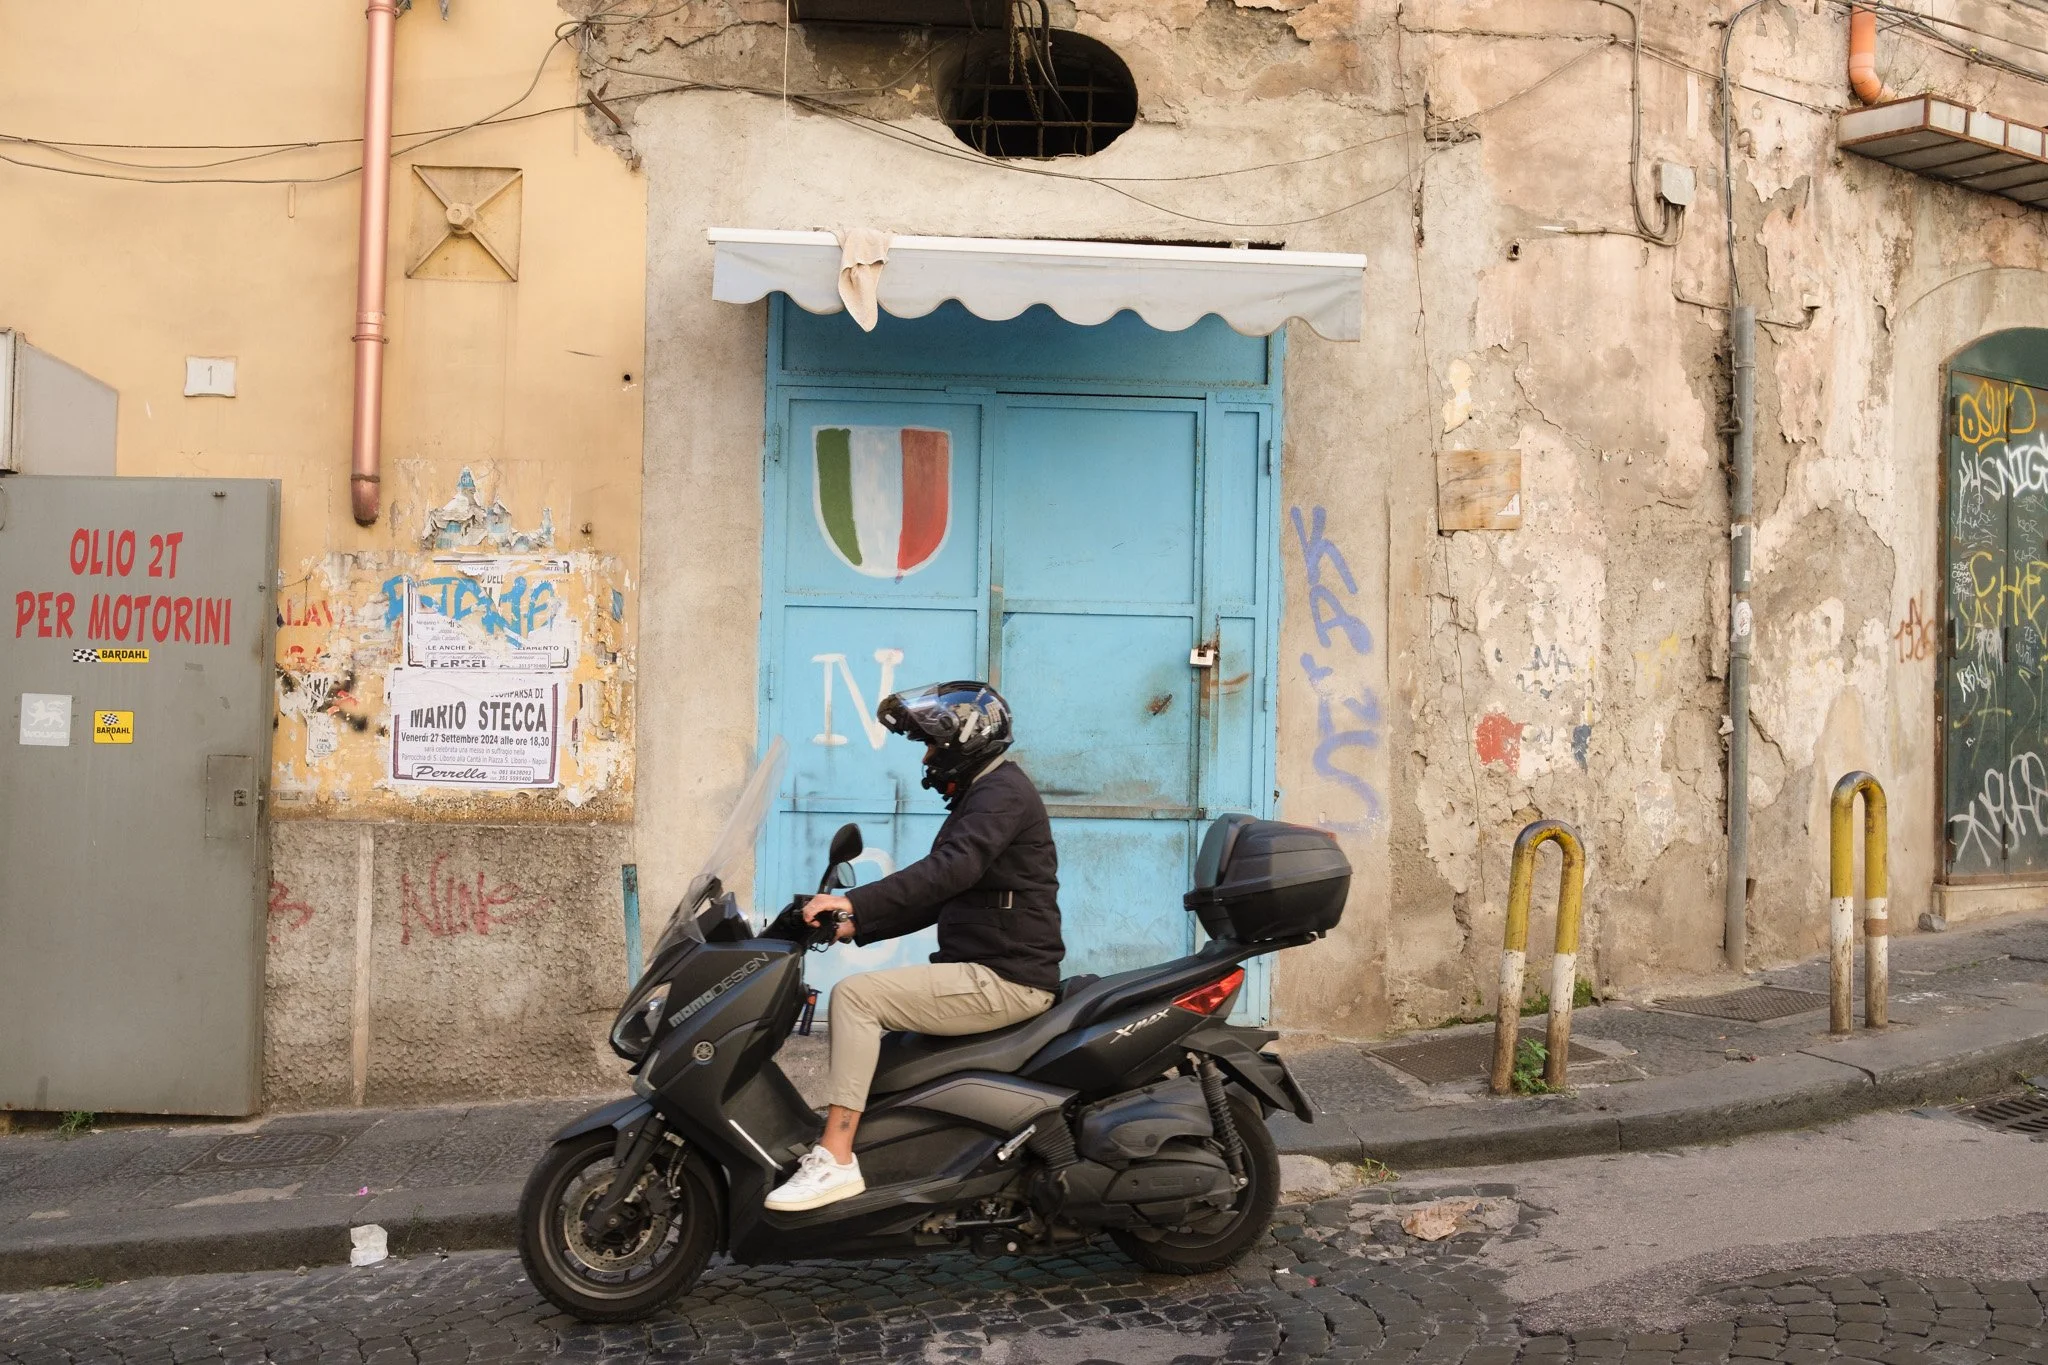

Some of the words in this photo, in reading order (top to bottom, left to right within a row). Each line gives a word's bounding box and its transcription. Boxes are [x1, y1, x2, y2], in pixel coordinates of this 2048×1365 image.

[207, 365, 213, 386] 1
[70, 528, 136, 577] OLIO
[149, 531, 184, 579] 2T
[16, 590, 76, 639] PER
[88, 593, 232, 646] MOTORINI
[102, 650, 148, 660] BARDAHL
[535, 688, 544, 699] DI
[478, 701, 547, 732] STECCA
[96, 726, 130, 737] BARDAHL
[431, 733, 439, 743] 27
[441, 733, 478, 744] Settembre
[480, 735, 498, 744] 2024
[500, 736, 514, 745] alle
[516, 738, 528, 746] ore
[530, 737, 550, 748] 18,30
[416, 765, 488, 779] Perrella
